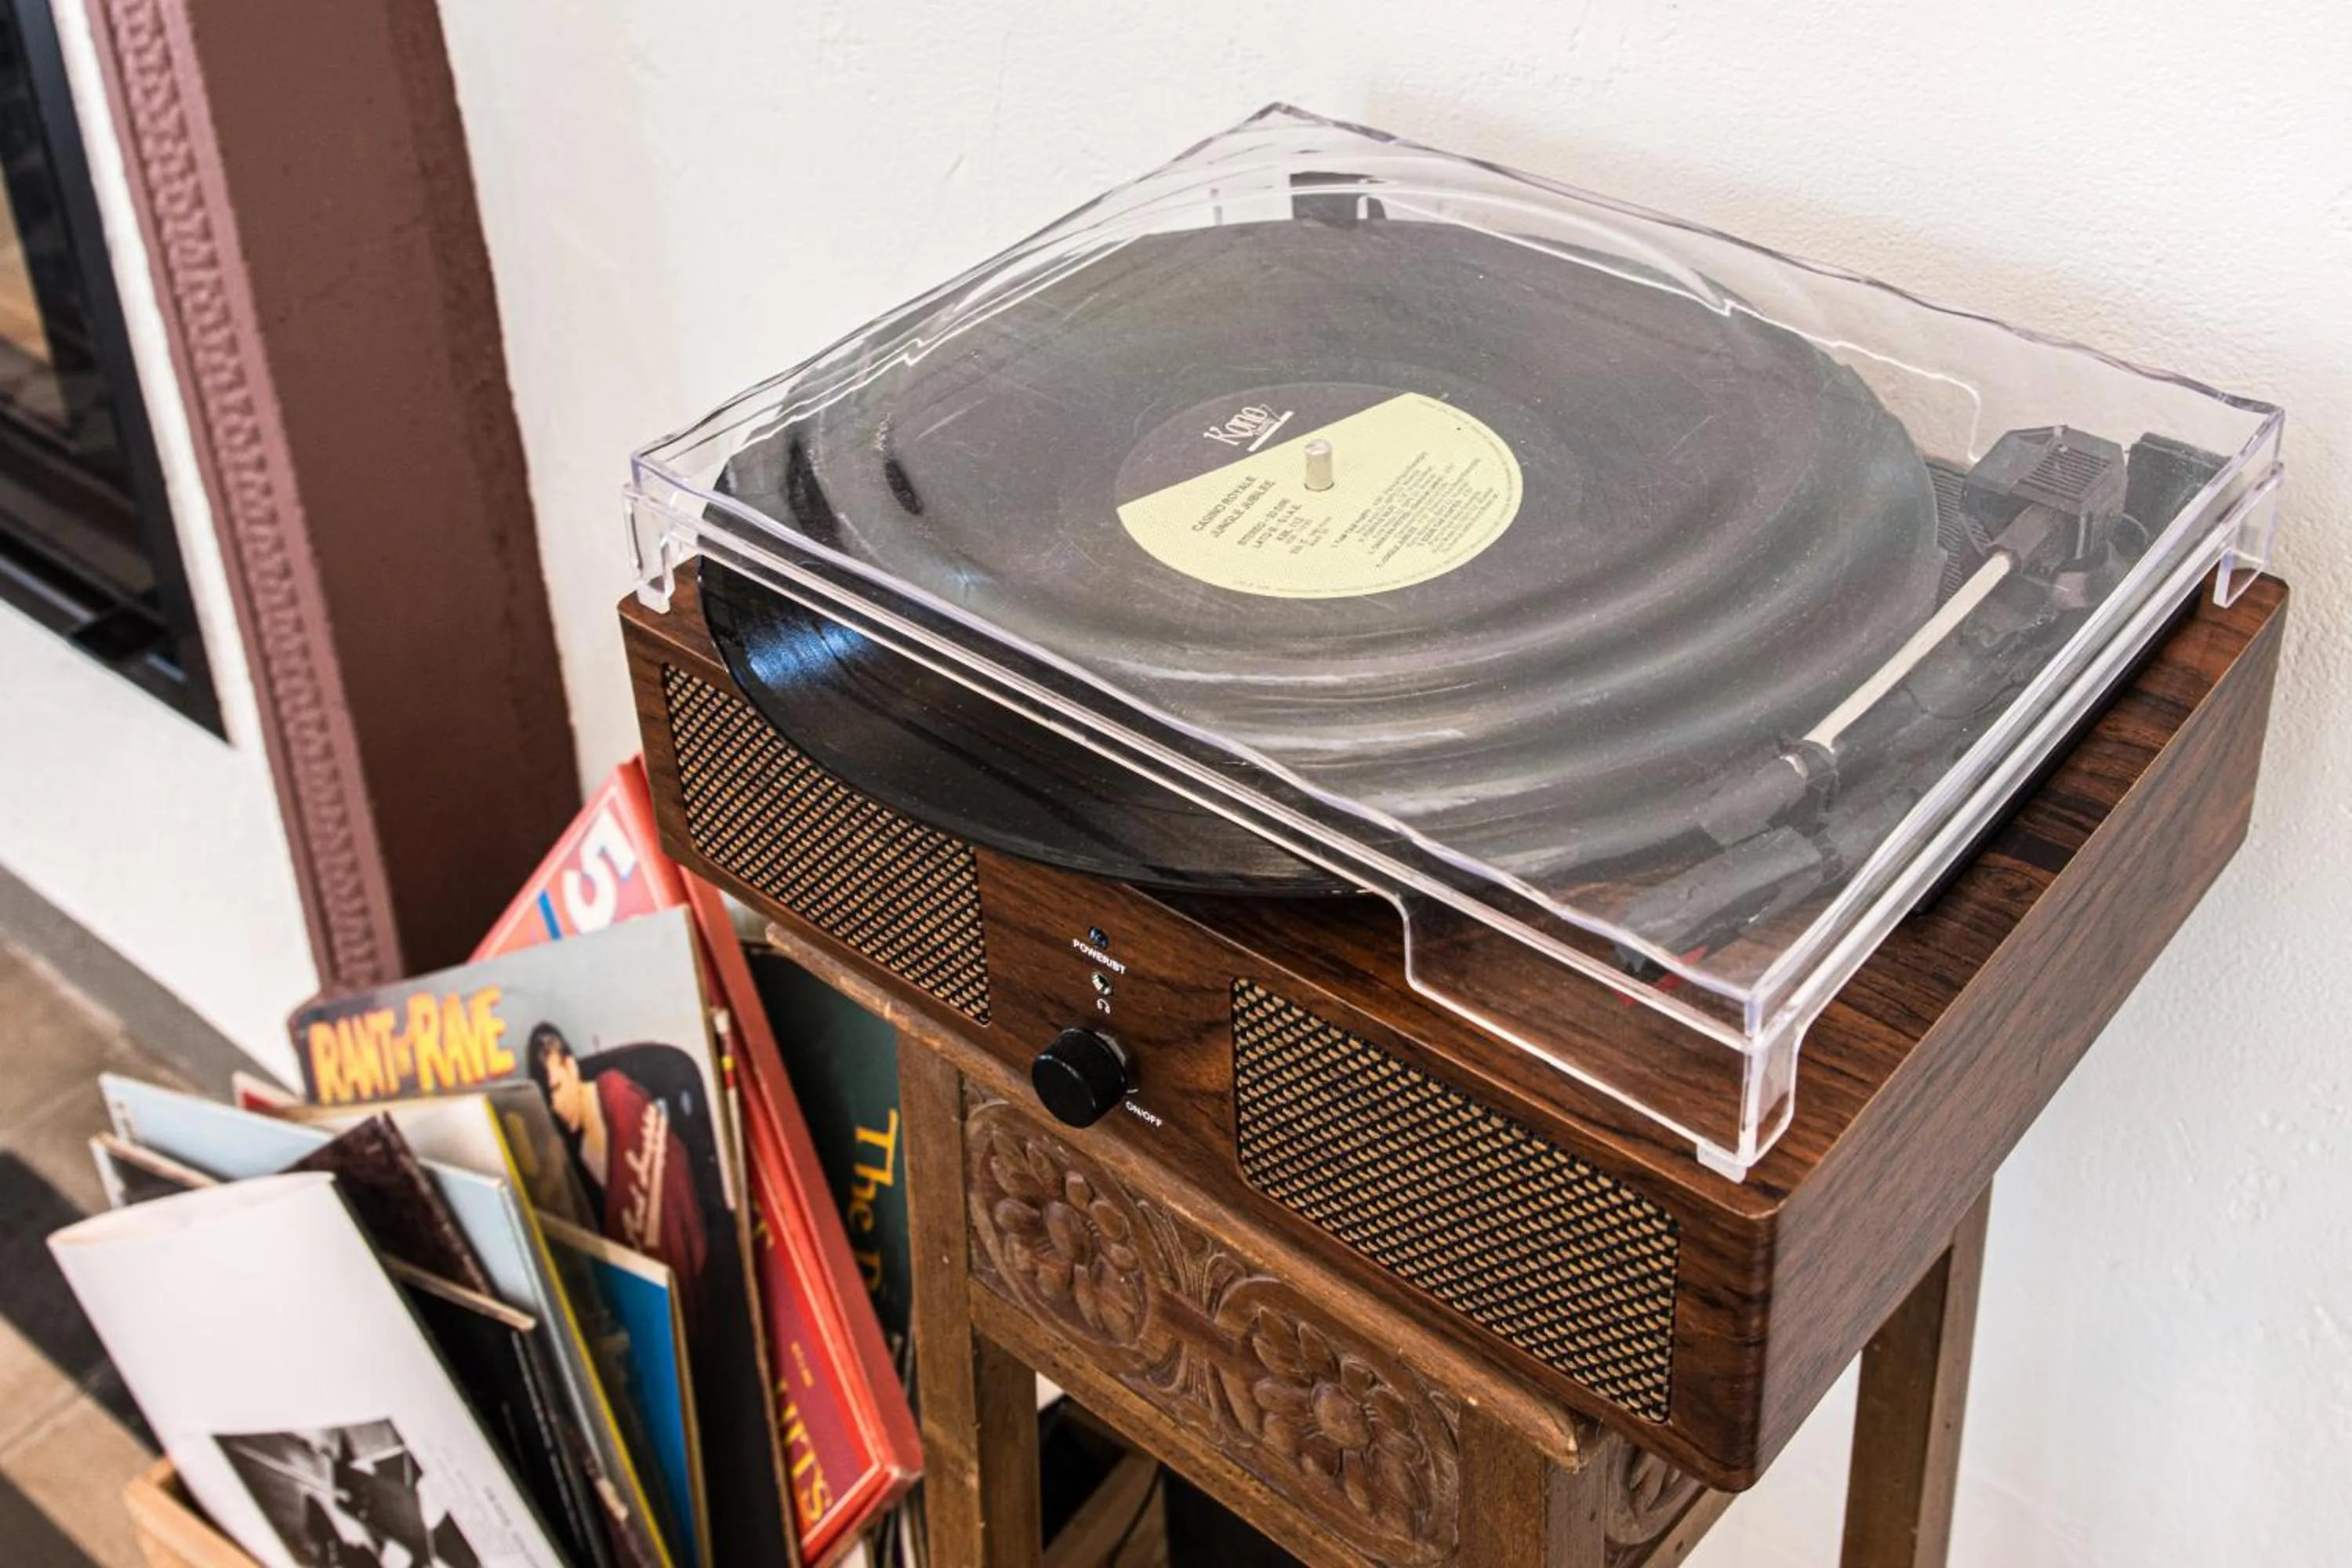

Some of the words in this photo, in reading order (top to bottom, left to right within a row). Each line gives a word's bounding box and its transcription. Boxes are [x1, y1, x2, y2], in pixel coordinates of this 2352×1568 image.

[1221, 475, 1256, 505] ROYALE
[308, 1006, 401, 1105] RANT
[406, 984, 517, 1094] RAVE
